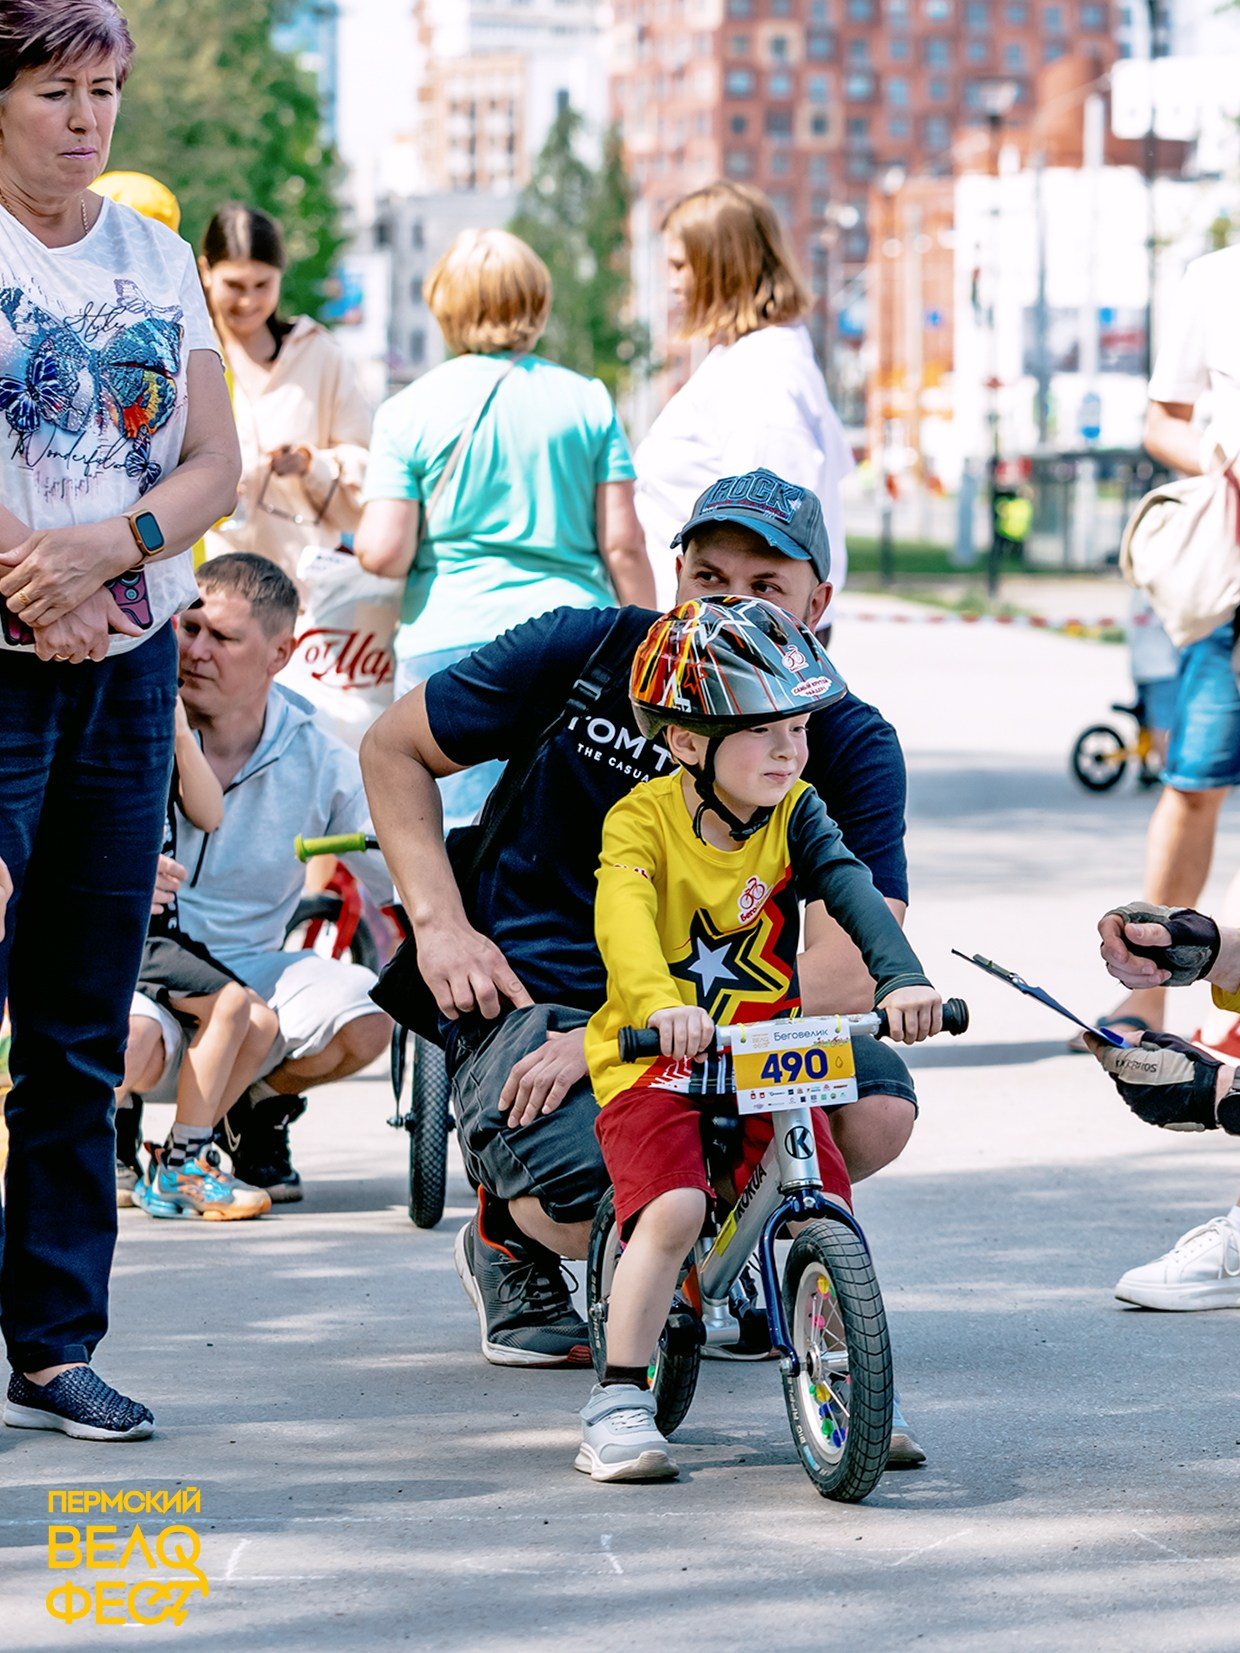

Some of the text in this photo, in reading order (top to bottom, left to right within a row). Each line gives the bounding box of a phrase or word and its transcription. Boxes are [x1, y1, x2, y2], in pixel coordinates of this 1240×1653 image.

[710, 474, 800, 514] ROCK
[567, 716, 647, 760] TOM
[576, 743, 603, 761] THE
[773, 1028, 829, 1042] Беговелик
[760, 1048, 828, 1083] 490
